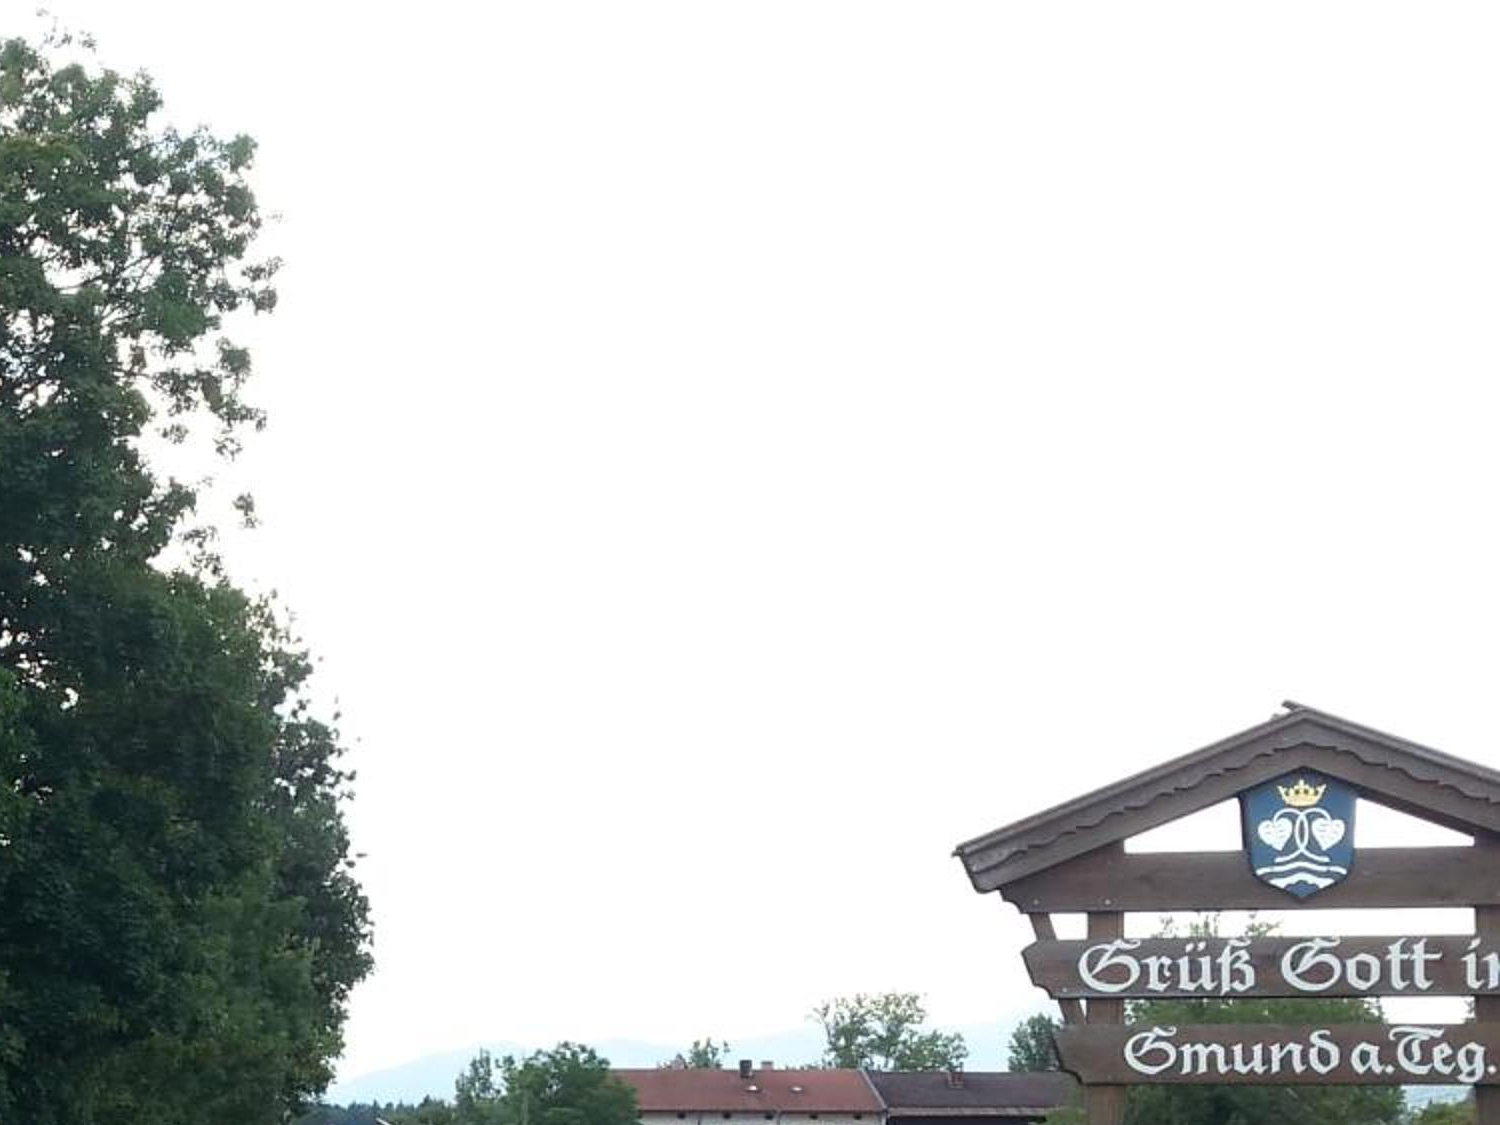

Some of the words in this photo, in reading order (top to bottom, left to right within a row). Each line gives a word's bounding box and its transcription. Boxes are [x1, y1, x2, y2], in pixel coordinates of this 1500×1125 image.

[1078, 938, 1255, 996] Grüß
[1281, 937, 1443, 991] Gott
[1124, 1025, 1341, 1075] Gmund
